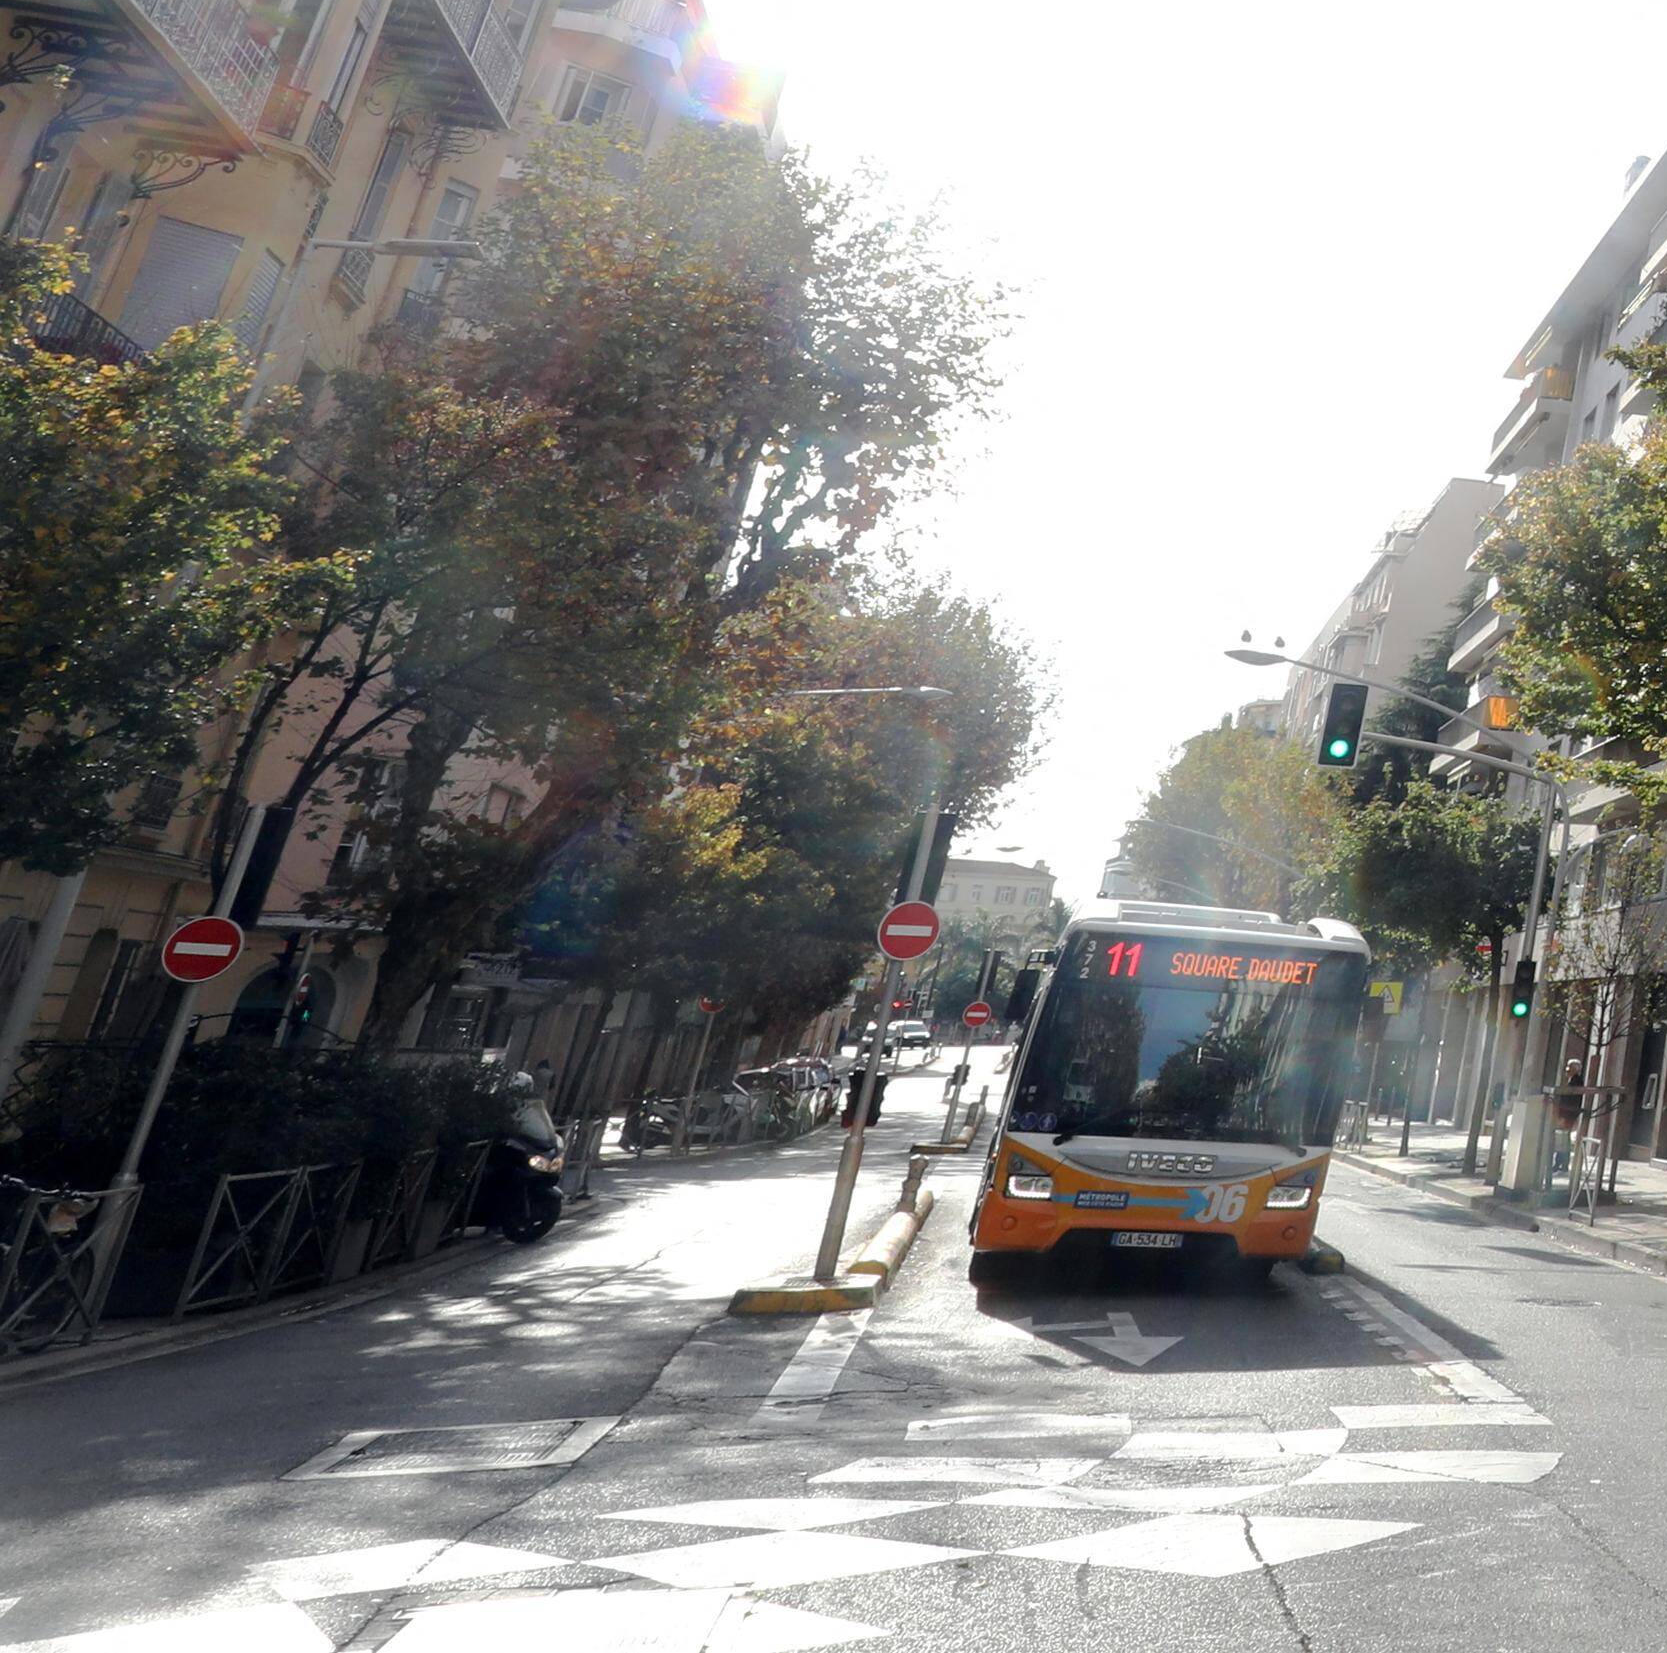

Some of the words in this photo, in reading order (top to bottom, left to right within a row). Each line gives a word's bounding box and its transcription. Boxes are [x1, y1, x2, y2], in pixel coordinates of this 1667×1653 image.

[1106, 942, 1143, 977] 11
[1170, 953, 1243, 980] SQUARE
[1247, 960, 1318, 984] DAUDET
[1127, 1151, 1215, 1173] IVECO
[1194, 1183, 1249, 1224] 06
